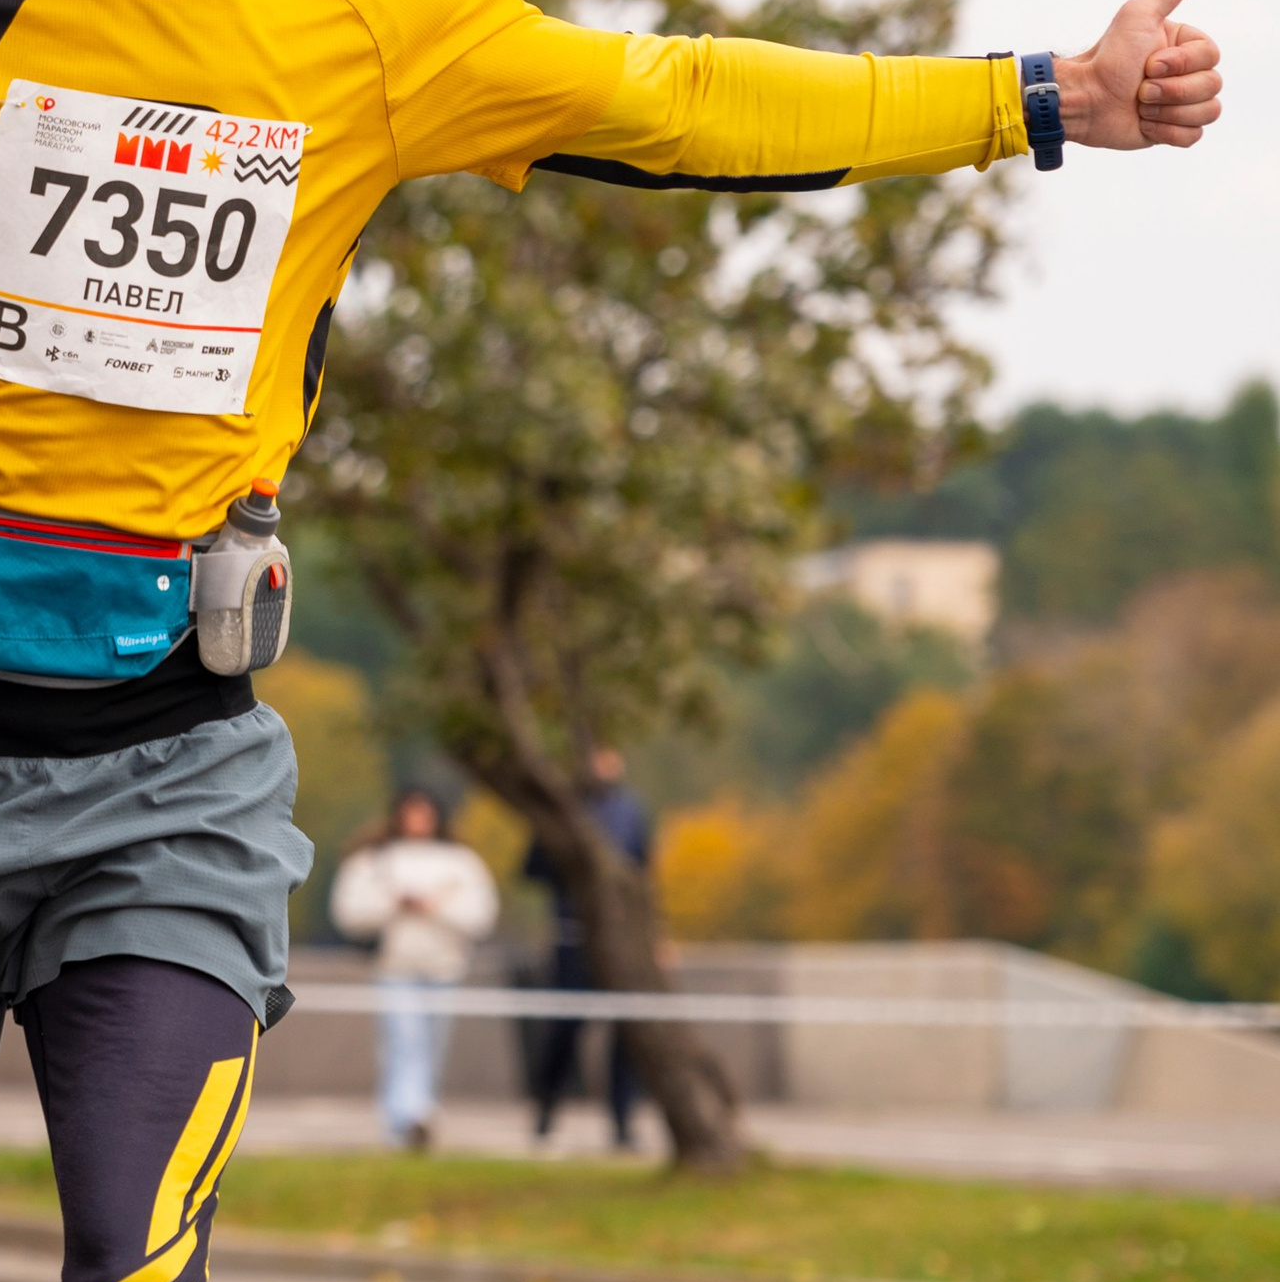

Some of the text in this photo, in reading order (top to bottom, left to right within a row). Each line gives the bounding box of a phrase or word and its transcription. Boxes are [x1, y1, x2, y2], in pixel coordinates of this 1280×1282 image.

[37, 122, 83, 137] МАРАФОН
[38, 114, 101, 131] МОСКОВСКИЙ
[36, 130, 76, 144] MOSCOW
[205, 120, 261, 149] 42,2
[34, 138, 84, 153] MARATHON
[29, 166, 257, 283] 7350
[82, 278, 184, 315] ПАВЕЛ
[201, 345, 234, 355] СИБУР
[104, 358, 154, 374] FONBET
[185, 370, 214, 379] МАГНИТ
[116, 633, 168, 647] Ultralight
